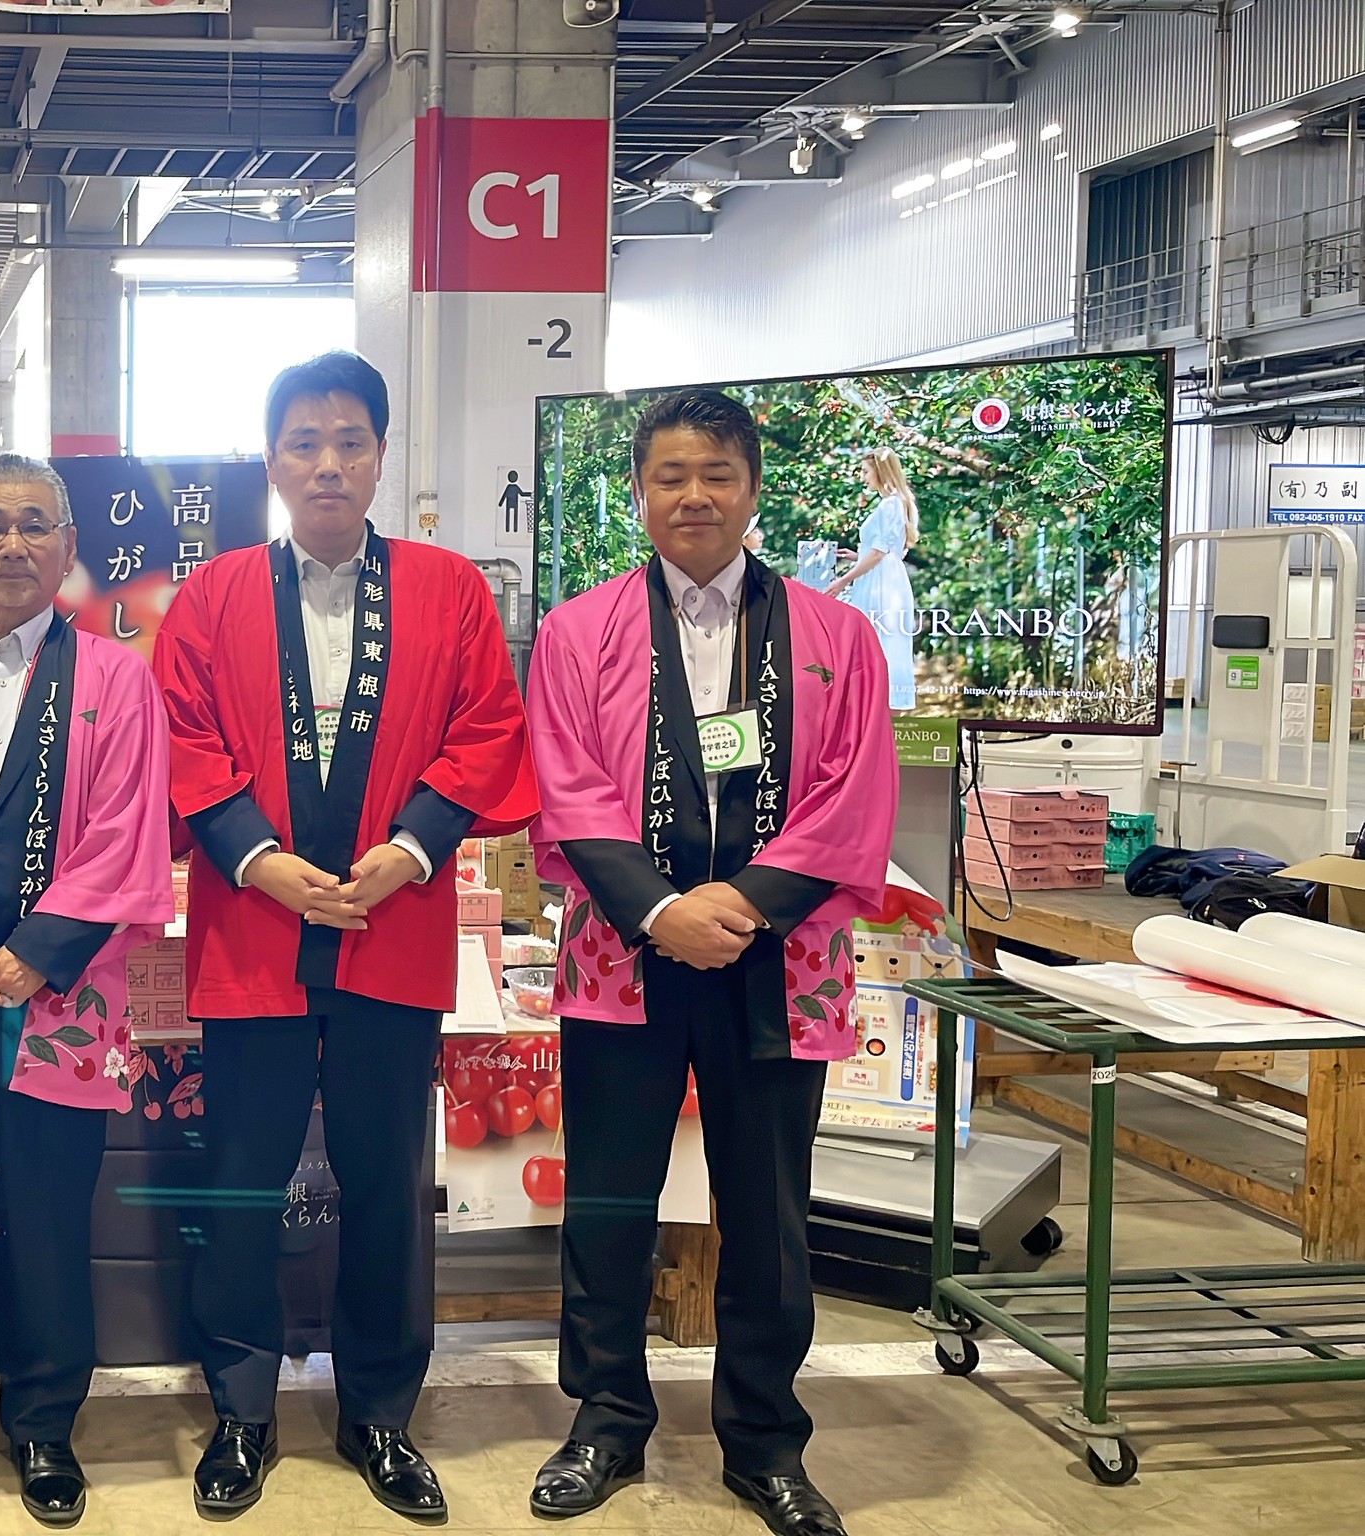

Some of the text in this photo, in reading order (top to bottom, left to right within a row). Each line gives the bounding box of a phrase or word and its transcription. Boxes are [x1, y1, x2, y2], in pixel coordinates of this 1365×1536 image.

[467, 171, 560, 239] C1
[528, 319, 572, 359] -2
[1083, 420, 1123, 430] HERRY
[172, 483, 212, 582] 高品
[1273, 513, 1364, 522] TEL 092-405-1910 FAX
[107, 488, 145, 638] ひがし
[869, 607, 1094, 638] KURANBO
[349, 556, 385, 733] 山形県東根市
[282, 1204, 341, 1229] くらん
